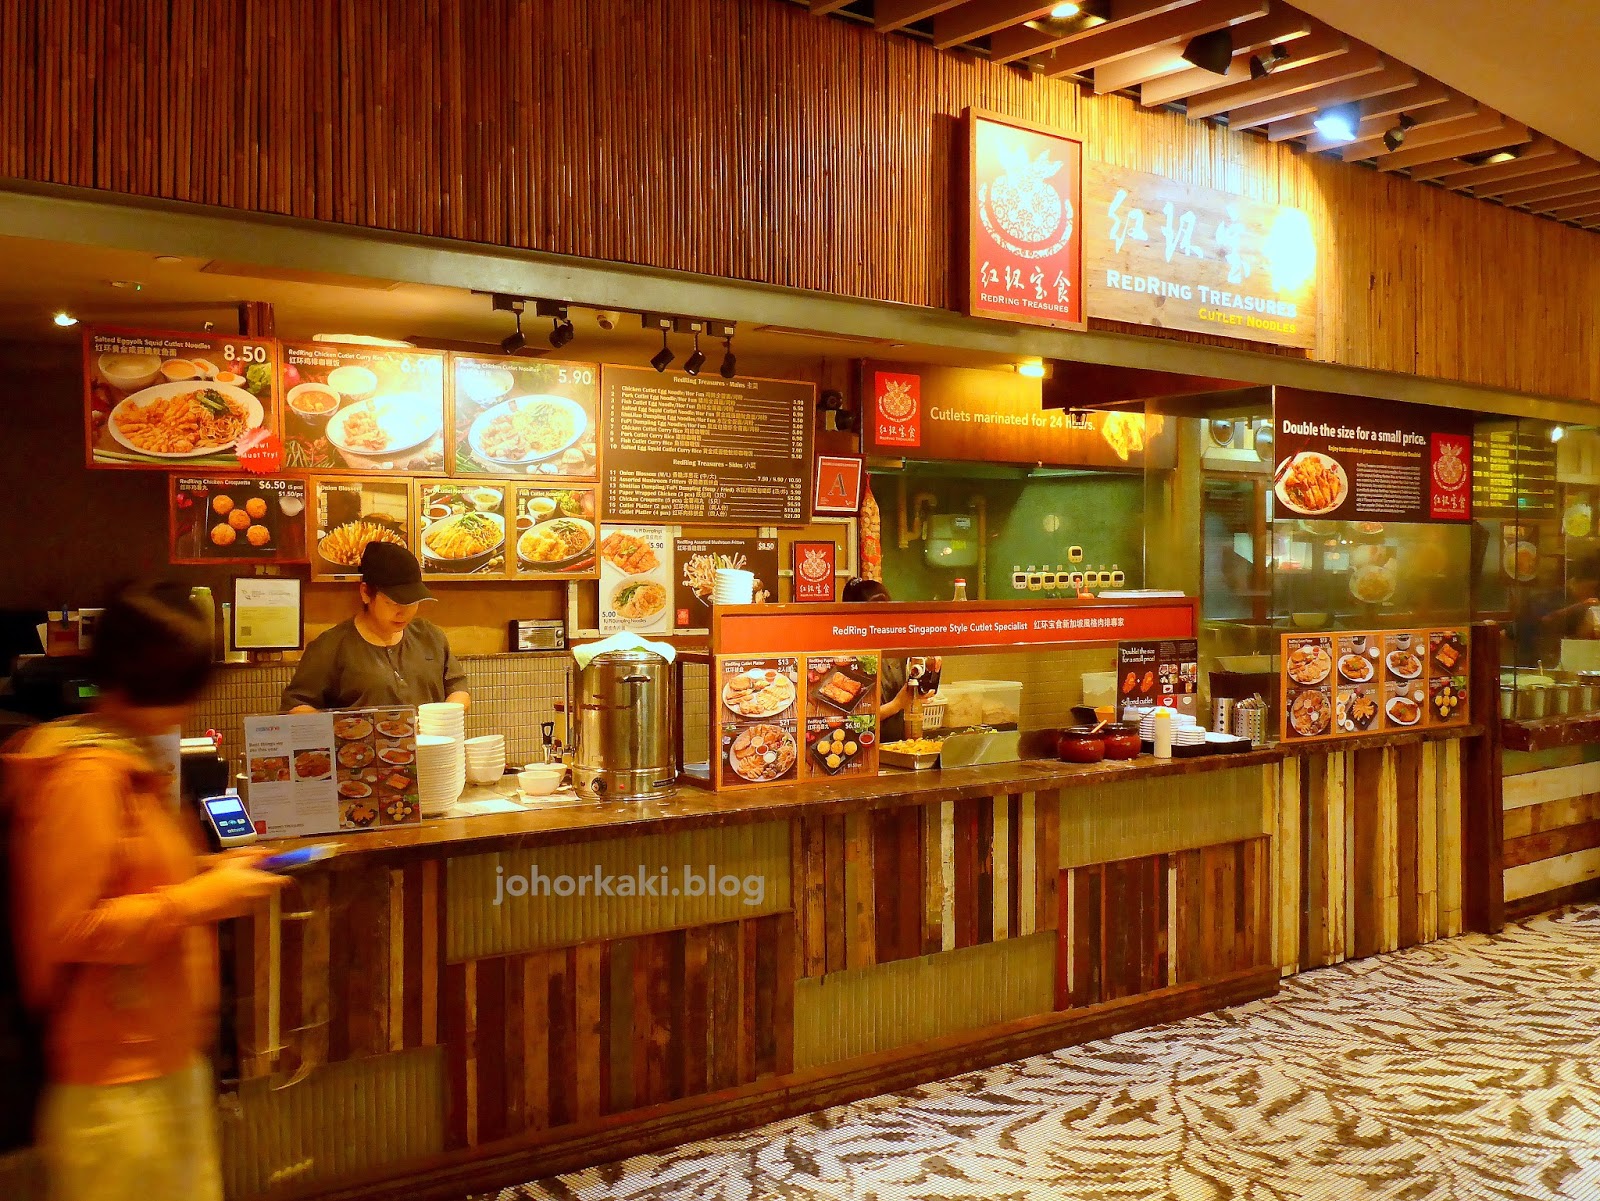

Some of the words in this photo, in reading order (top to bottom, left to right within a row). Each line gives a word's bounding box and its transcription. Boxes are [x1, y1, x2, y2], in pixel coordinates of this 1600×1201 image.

[117, 337, 143, 346] Eggyolk
[224, 344, 266, 363] 8.50
[288, 349, 313, 357] RedRing
[356, 353, 372, 362] Curry
[558, 369, 592, 385] 5.90
[698, 378, 725, 387] Treasures
[930, 406, 971, 422] Cutlets
[974, 411, 1028, 426] marinated
[1031, 414, 1047, 427] for
[1050, 415, 1063, 428] 24
[1282, 420, 1318, 436] Double
[1320, 423, 1336, 437] the
[1337, 425, 1355, 439] size
[1356, 426, 1370, 440] for
[1371, 432, 1377, 441] a
[1378, 430, 1402, 443] small
[1402, 432, 1427, 446] price.
[258, 481, 286, 490] $6.50
[828, 472, 847, 497] A
[832, 626, 867, 636] RedRing
[869, 625, 906, 634] Treasures
[908, 624, 948, 636] Singapore
[949, 623, 968, 635] Style
[970, 623, 992, 632] Cutlet
[994, 622, 1028, 632] Specialist
[777, 658, 789, 666] $13
